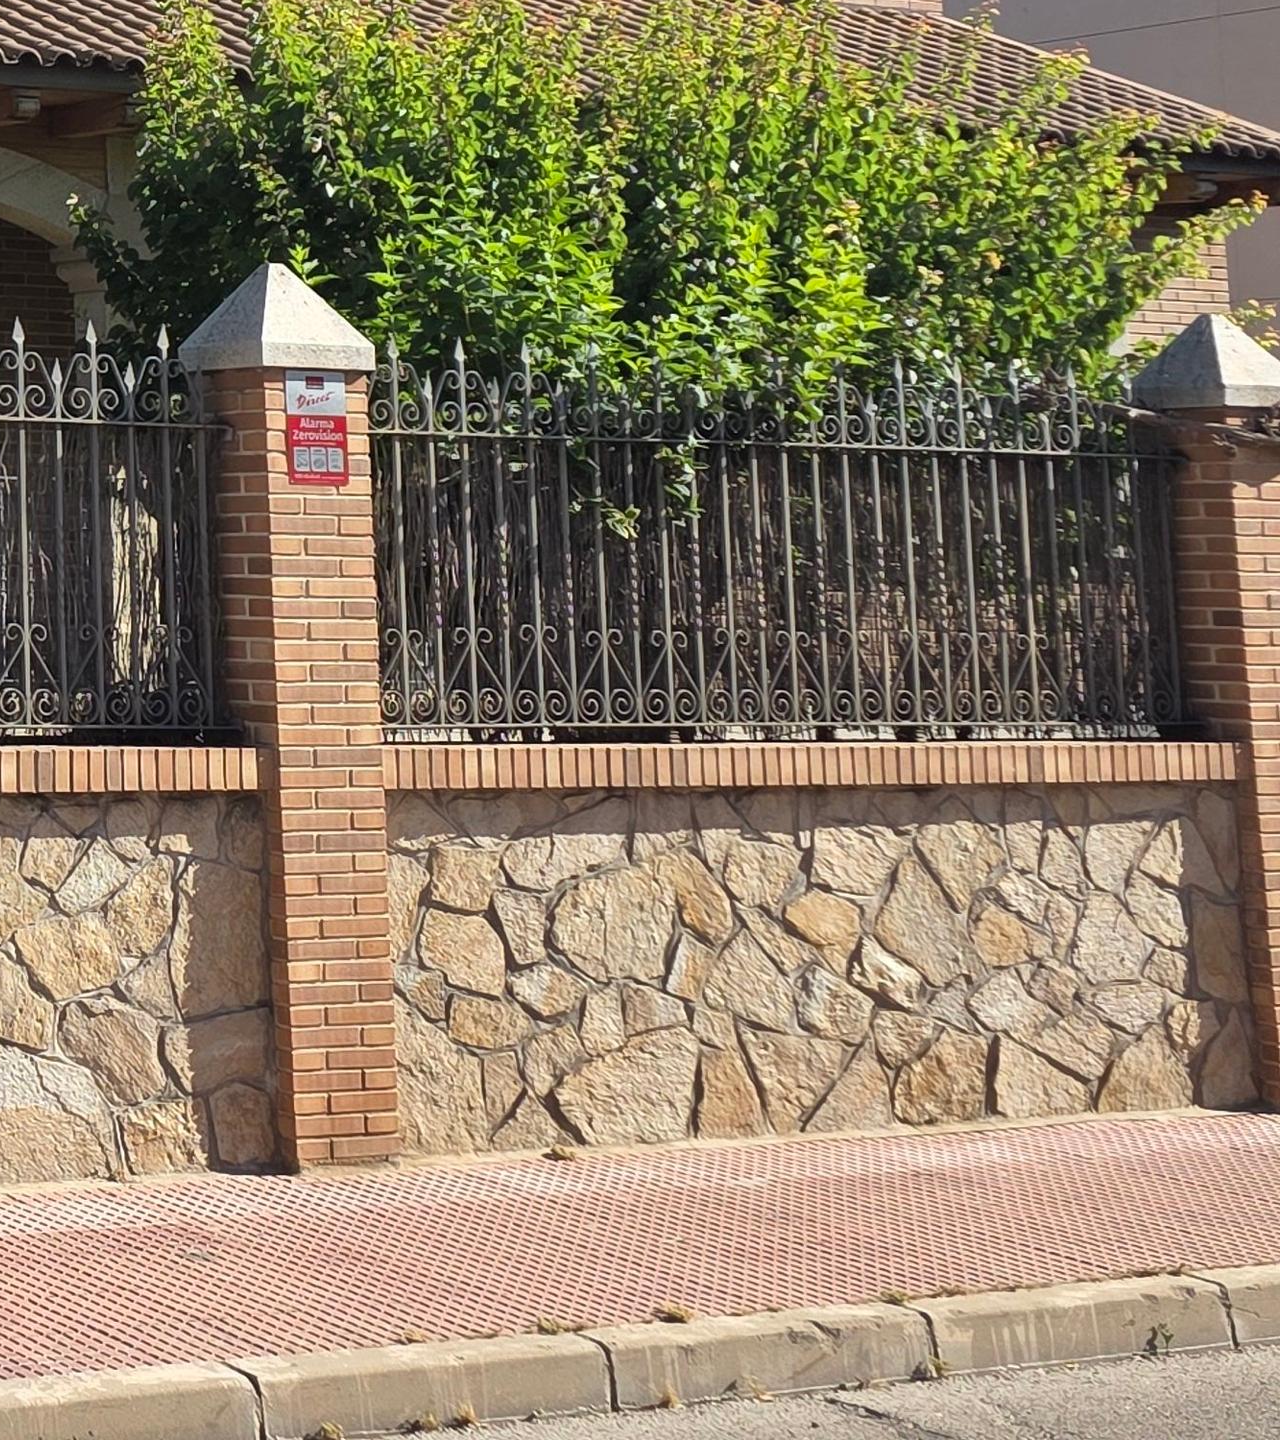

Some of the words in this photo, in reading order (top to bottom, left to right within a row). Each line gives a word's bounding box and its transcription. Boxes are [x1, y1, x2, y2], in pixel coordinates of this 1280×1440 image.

[296, 391, 335, 409] Direct
[299, 417, 335, 429] Alarma
[292, 429, 344, 441] Zerovision
